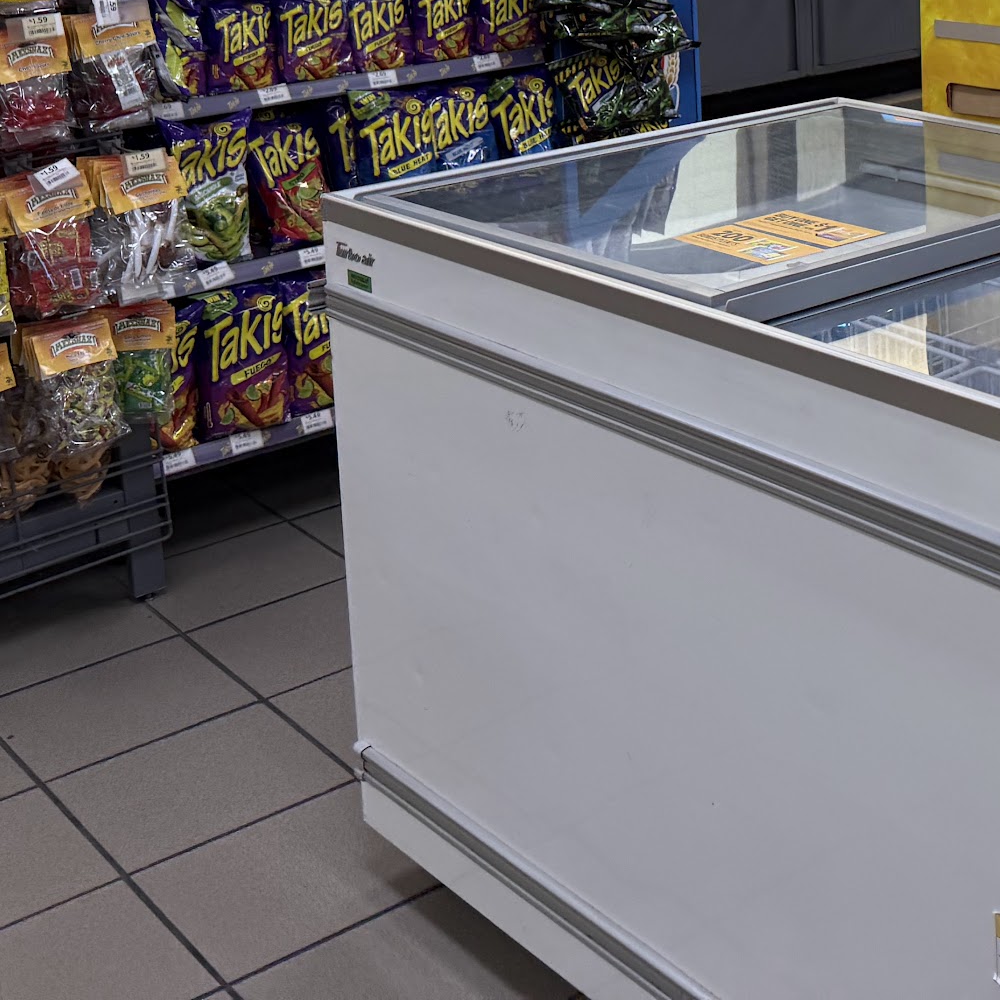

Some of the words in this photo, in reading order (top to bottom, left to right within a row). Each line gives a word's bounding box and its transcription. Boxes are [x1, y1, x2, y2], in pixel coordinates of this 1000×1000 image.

[28, 16, 48, 25] $1.59
[567, 55, 622, 113] Takis
[131, 152, 150, 161] $1.59
[248, 123, 321, 189] Takis
[391, 162, 411, 175] BLUE
[412, 153, 431, 167] HEAT
[41, 164, 59, 176] $1.59
[713, 229, 754, 242] 200
[204, 294, 284, 383] Takis
[244, 357, 275, 380] FUEGO
